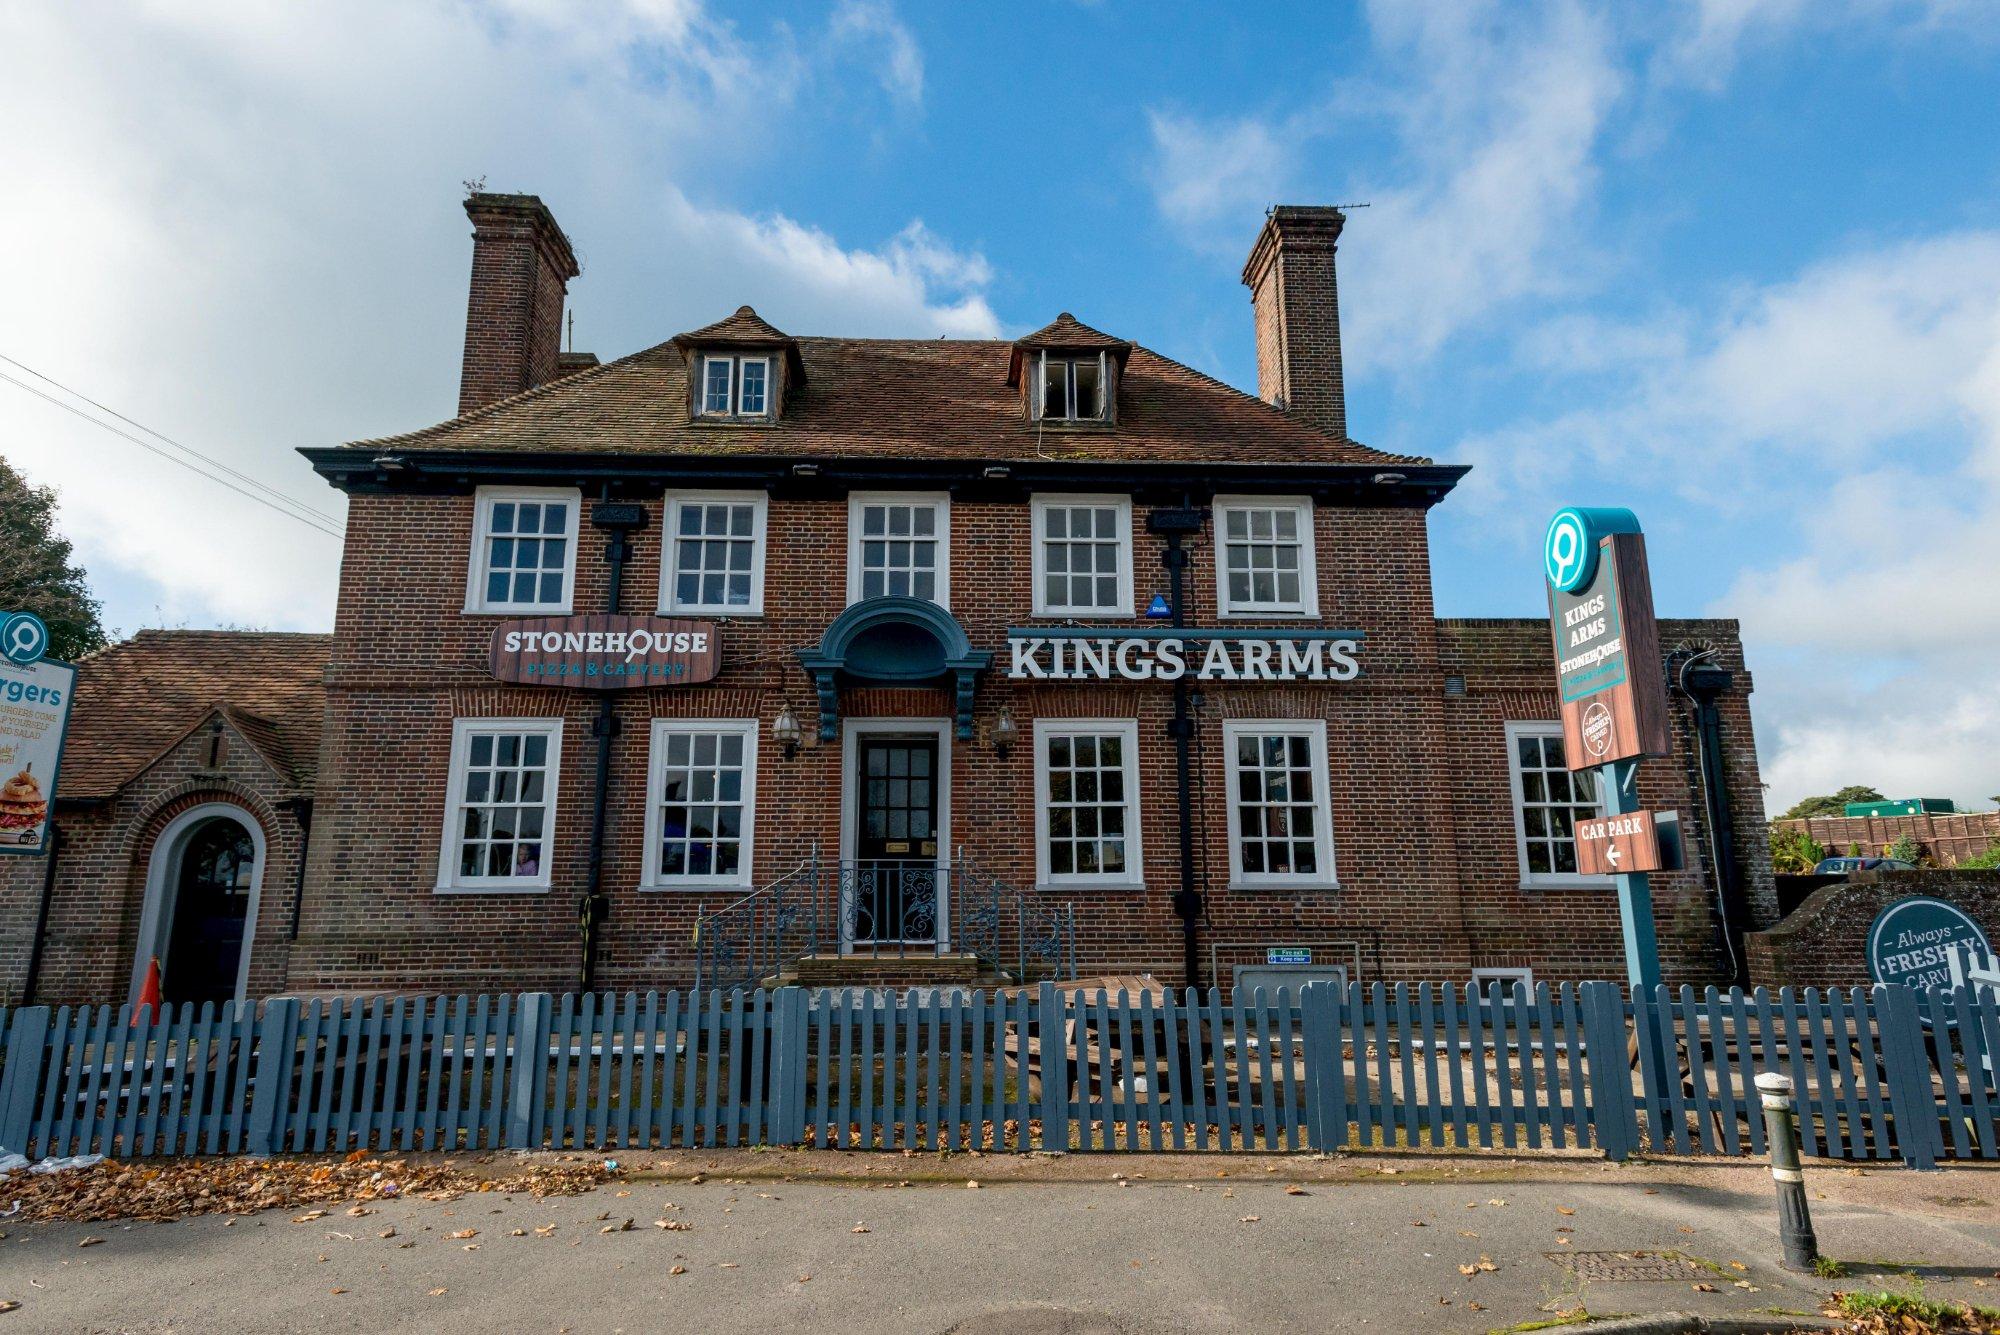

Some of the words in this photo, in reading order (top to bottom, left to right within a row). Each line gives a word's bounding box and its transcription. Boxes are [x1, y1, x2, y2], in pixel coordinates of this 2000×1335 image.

[1564, 594, 1604, 627] KINGS
[504, 629, 707, 663] STONEHOUSE
[1571, 617, 1606, 648] ARMS
[528, 663, 582, 676] PIZZA
[585, 662, 599, 677] &
[602, 662, 685, 677] CARVERY
[1007, 637, 1186, 680] KINGS
[1196, 638, 1359, 681] ARMS
[1560, 638, 1621, 675] STONEHOUSE
[1581, 822, 1606, 840] CAR
[1607, 817, 1643, 837] PARK
[1897, 927, 1951, 948] Always
[1883, 937, 1975, 975] FRESHY
[1906, 967, 1951, 990] CARV
